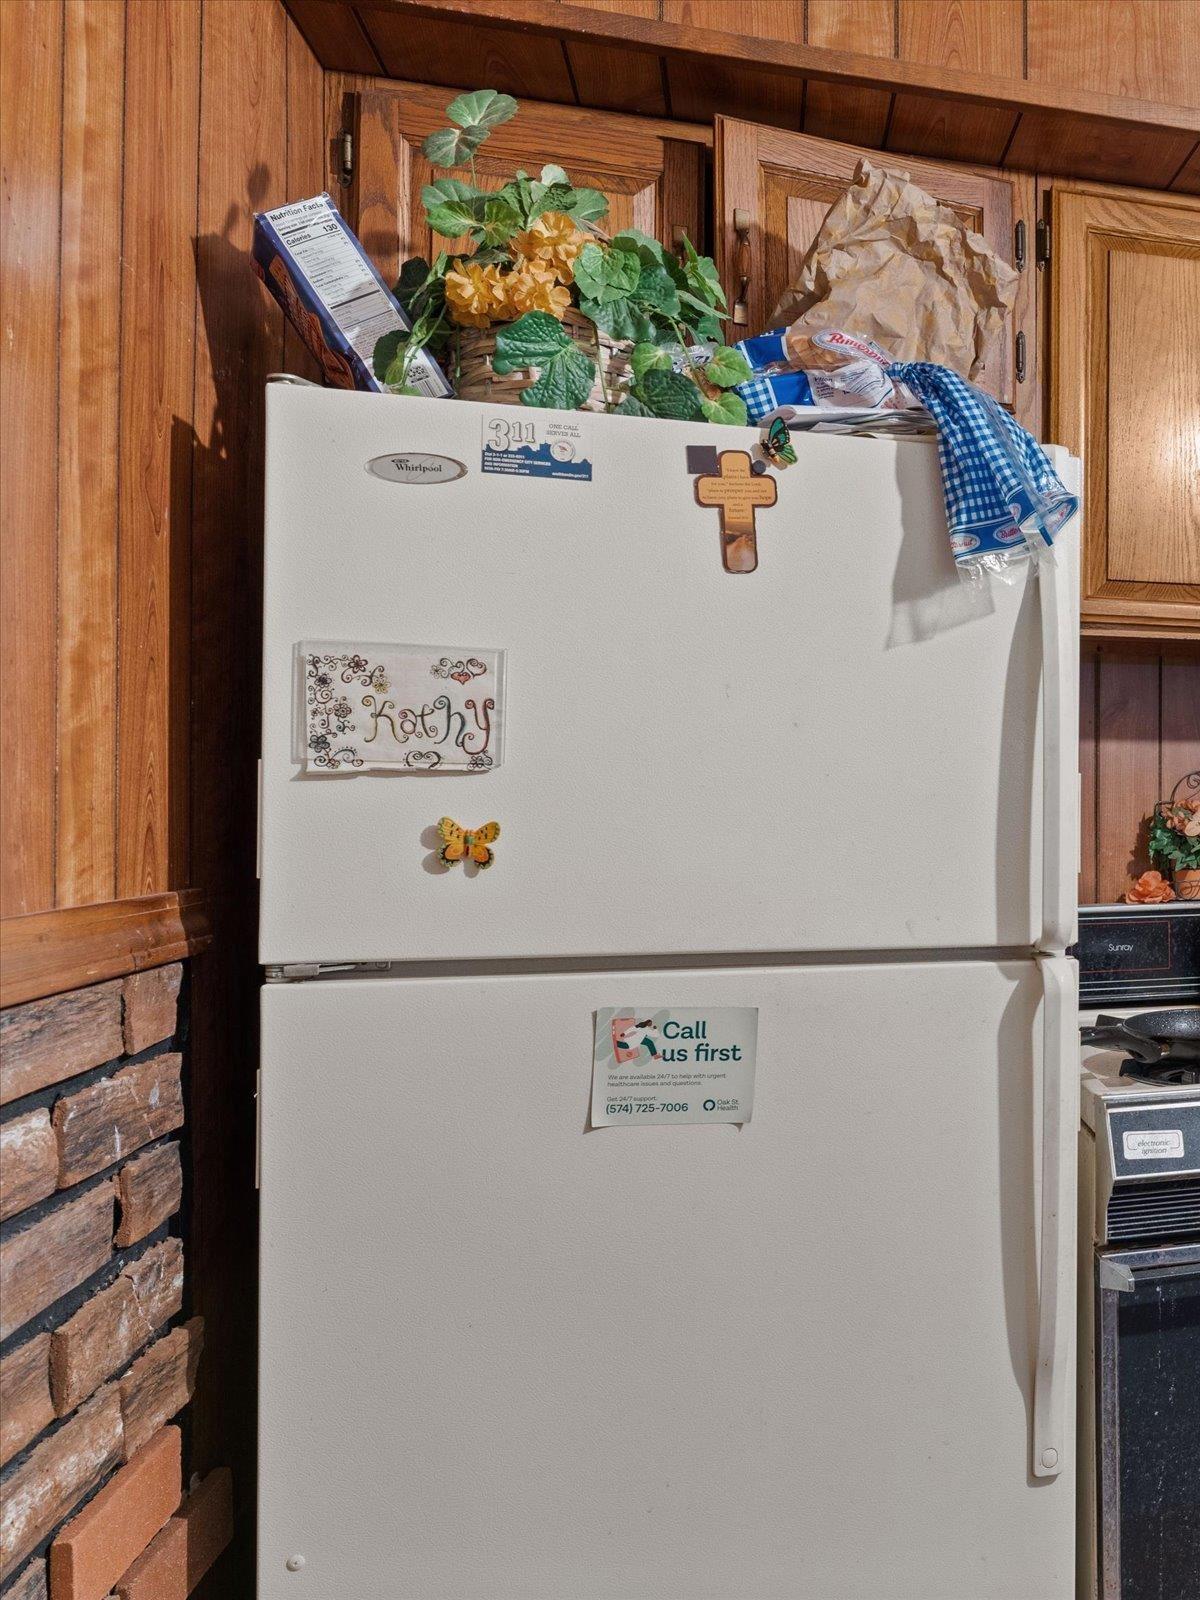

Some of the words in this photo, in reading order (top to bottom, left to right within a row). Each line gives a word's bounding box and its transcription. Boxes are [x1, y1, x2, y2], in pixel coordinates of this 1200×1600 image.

[270, 208, 302, 221] Nutrition
[303, 202, 323, 211] Facts
[286, 233, 311, 245] Calories
[323, 223, 338, 232] 130
[488, 418, 535, 451] 311
[395, 463, 442, 473] Whirlpool
[361, 695, 495, 755] Kathy
[1108, 943, 1134, 952] Sunray
[663, 1020, 707, 1040] Call
[662, 1048, 688, 1062] us
[695, 1043, 742, 1062] first
[605, 1103, 633, 1115] (574)
[636, 1102, 689, 1113] 725-7006
[1137, 1139, 1171, 1147] electronic
